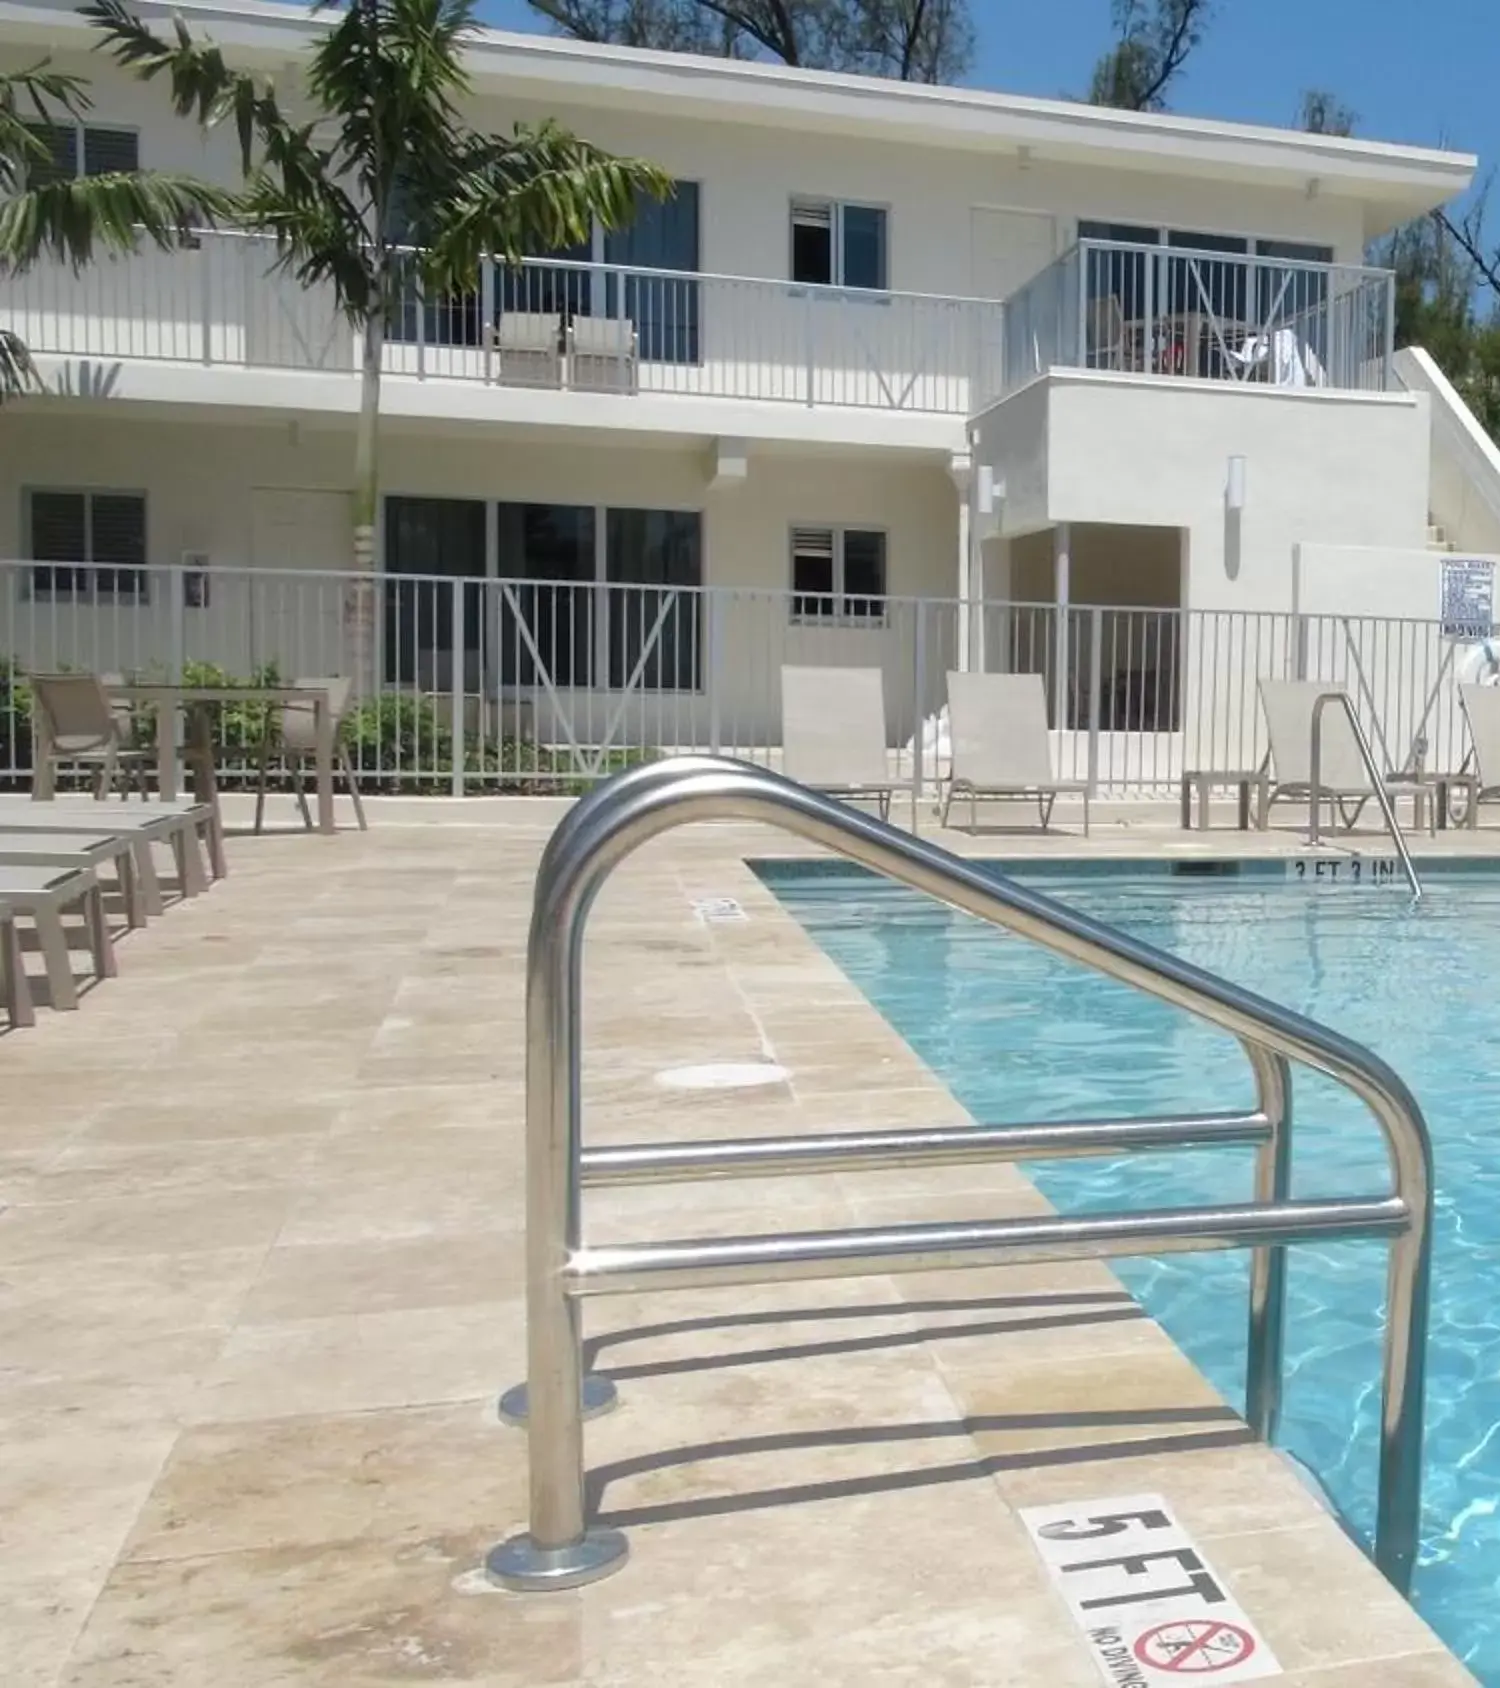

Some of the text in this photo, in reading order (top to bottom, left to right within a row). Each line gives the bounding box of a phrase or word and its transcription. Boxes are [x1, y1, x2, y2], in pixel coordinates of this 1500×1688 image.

[1315, 861, 1342, 882] FT
[1372, 860, 1395, 884] IN
[1037, 1509, 1227, 1611] 5 FT
[1088, 1626, 1149, 1688] NO DIVING
